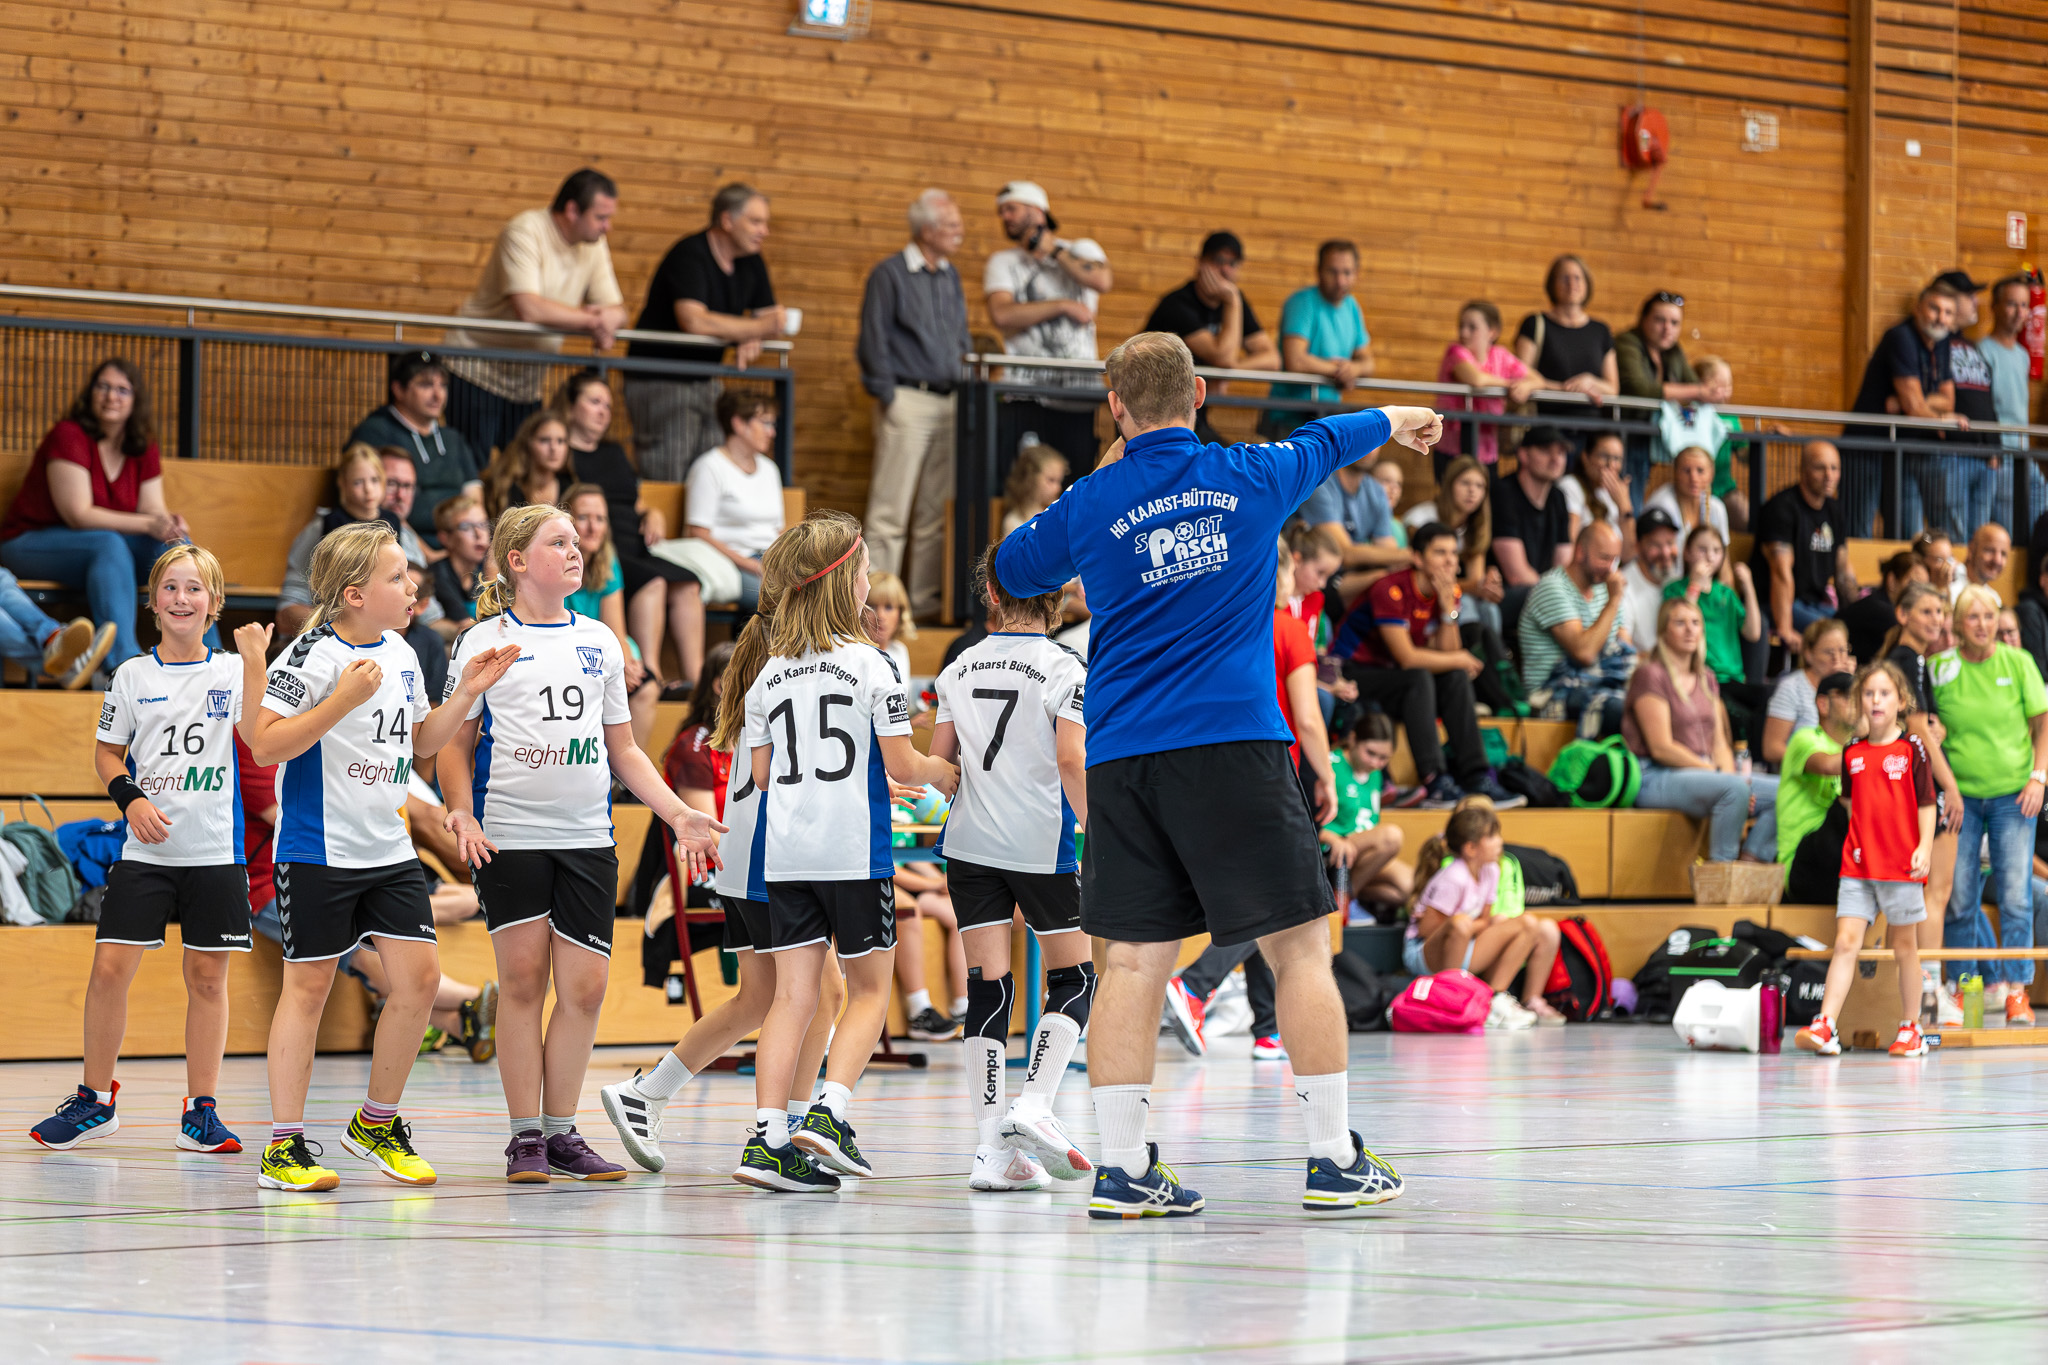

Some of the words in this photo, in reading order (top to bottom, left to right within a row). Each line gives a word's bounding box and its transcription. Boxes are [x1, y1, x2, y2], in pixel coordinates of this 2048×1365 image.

[1109, 518, 1131, 540] HG
[1127, 488, 1239, 526] KAARST-BÜTTGEN
[1143, 552, 1227, 582] TEAMSPORT
[1151, 564, 1222, 588] www.sportpasch.de
[766, 674, 782, 690] HG
[819, 661, 858, 687] Büttgen
[971, 660, 1006, 672] Kaarst
[1009, 660, 1046, 684] Büttgen
[279, 681, 304, 698] PLAY
[539, 685, 584, 722] 19
[160, 722, 205, 756] 16
[372, 707, 408, 744] 14
[768, 693, 856, 785] 15
[972, 688, 1019, 771] 7
[514, 737, 599, 769] eightMS
[140, 766, 227, 796] eightMS
[347, 756, 413, 785] eightM
[1026, 1030, 1051, 1083] Kempa
[984, 1049, 1000, 1106] Kempa
